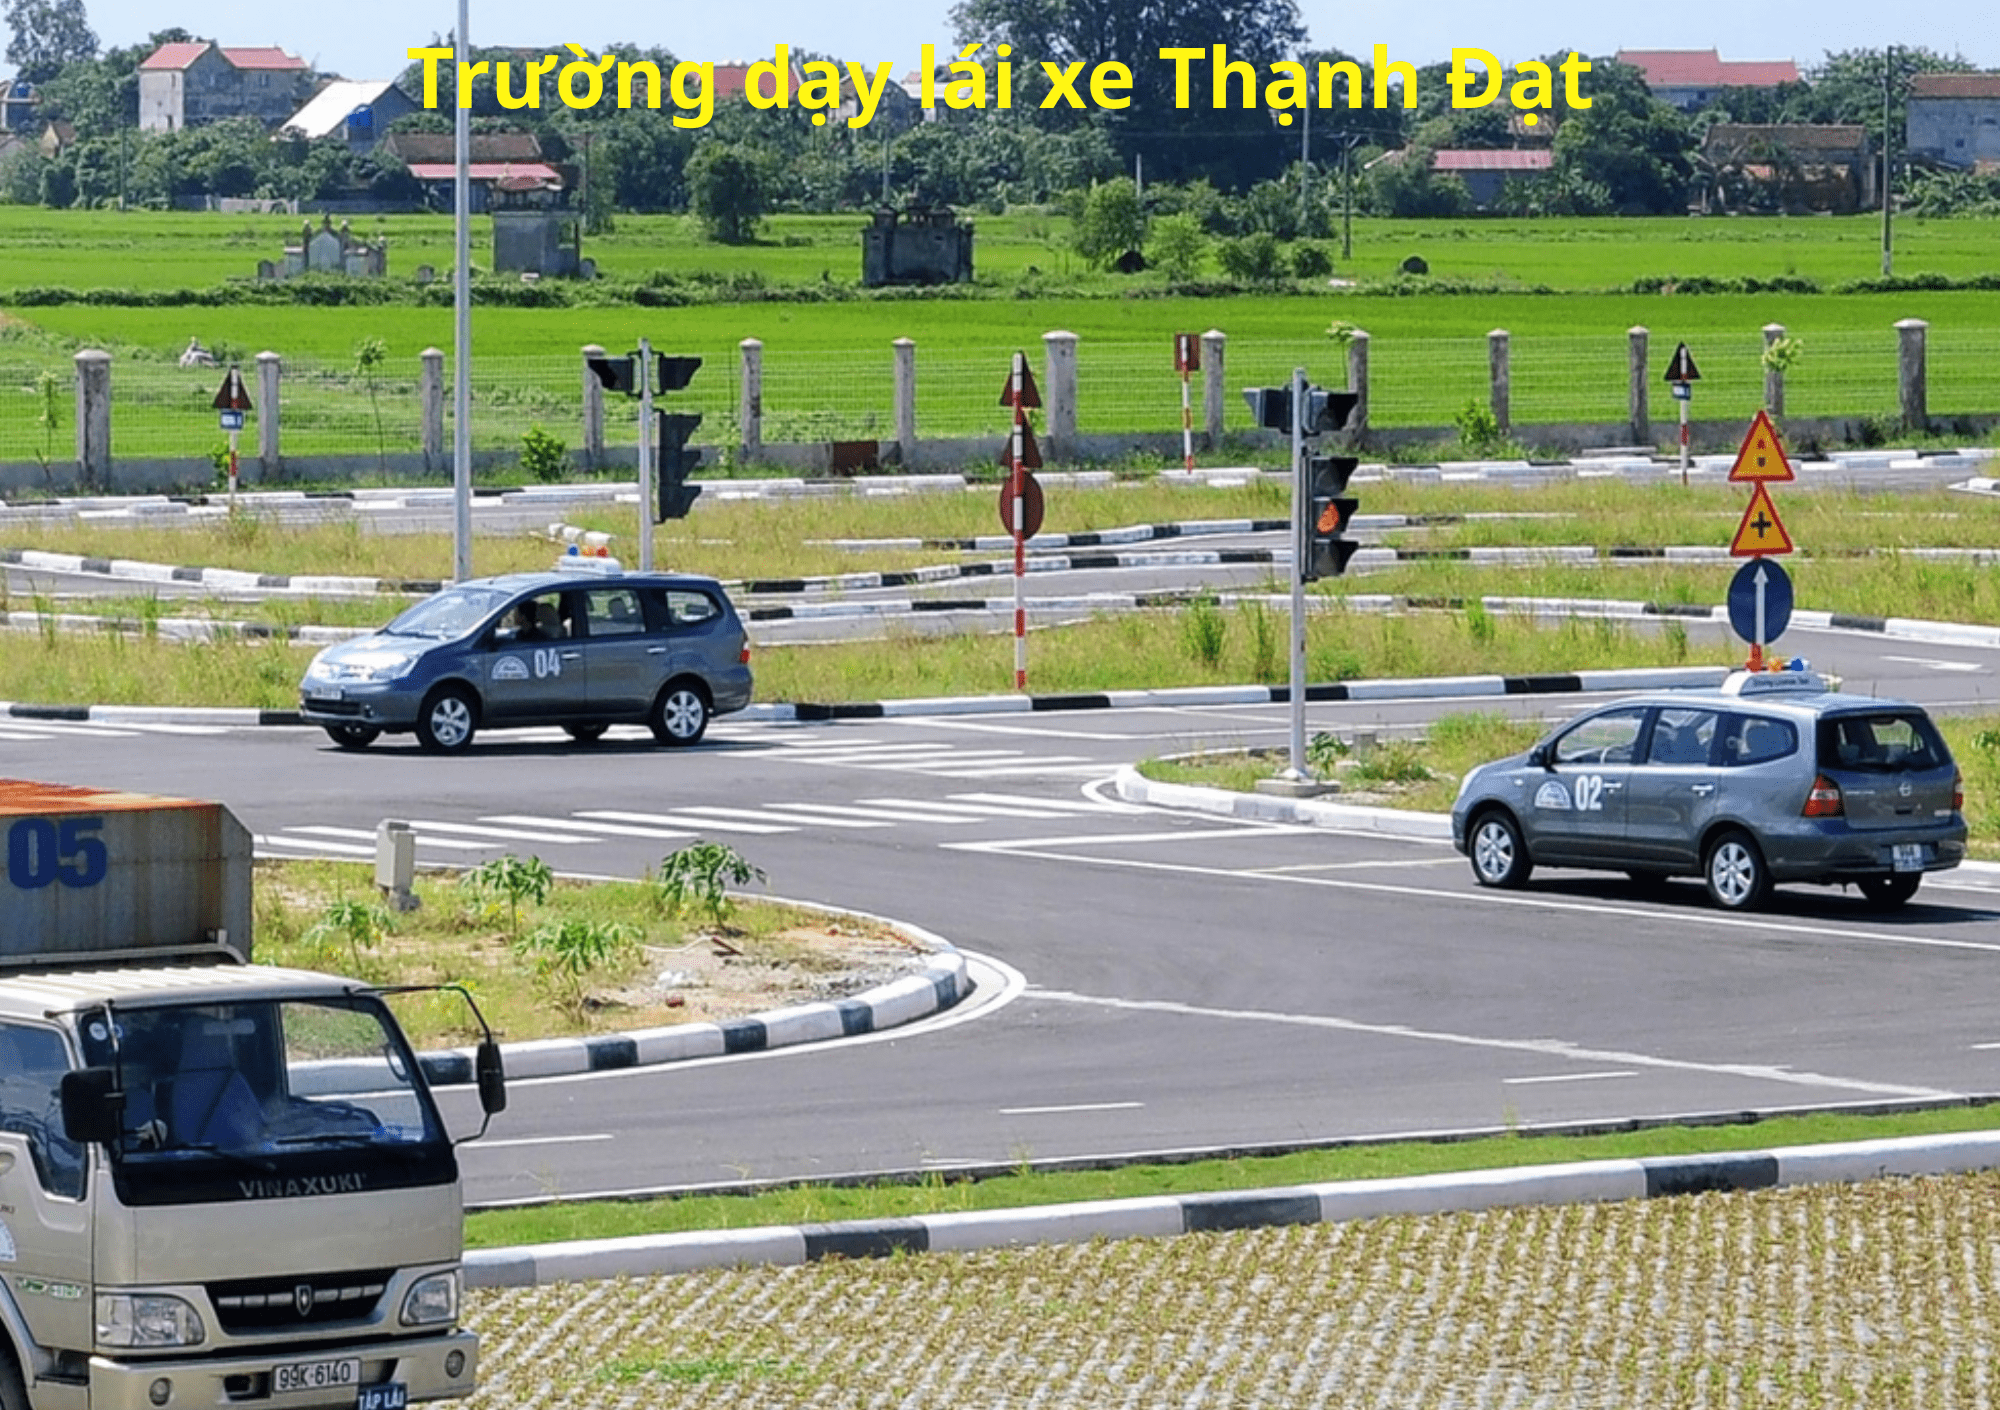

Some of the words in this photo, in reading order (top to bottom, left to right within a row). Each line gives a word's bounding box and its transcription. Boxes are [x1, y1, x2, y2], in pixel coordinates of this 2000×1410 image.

[534, 648, 561, 678] 04
[1575, 774, 1603, 811] 02
[8, 817, 107, 889] 05
[238, 1172, 363, 1198] VINAXUKI
